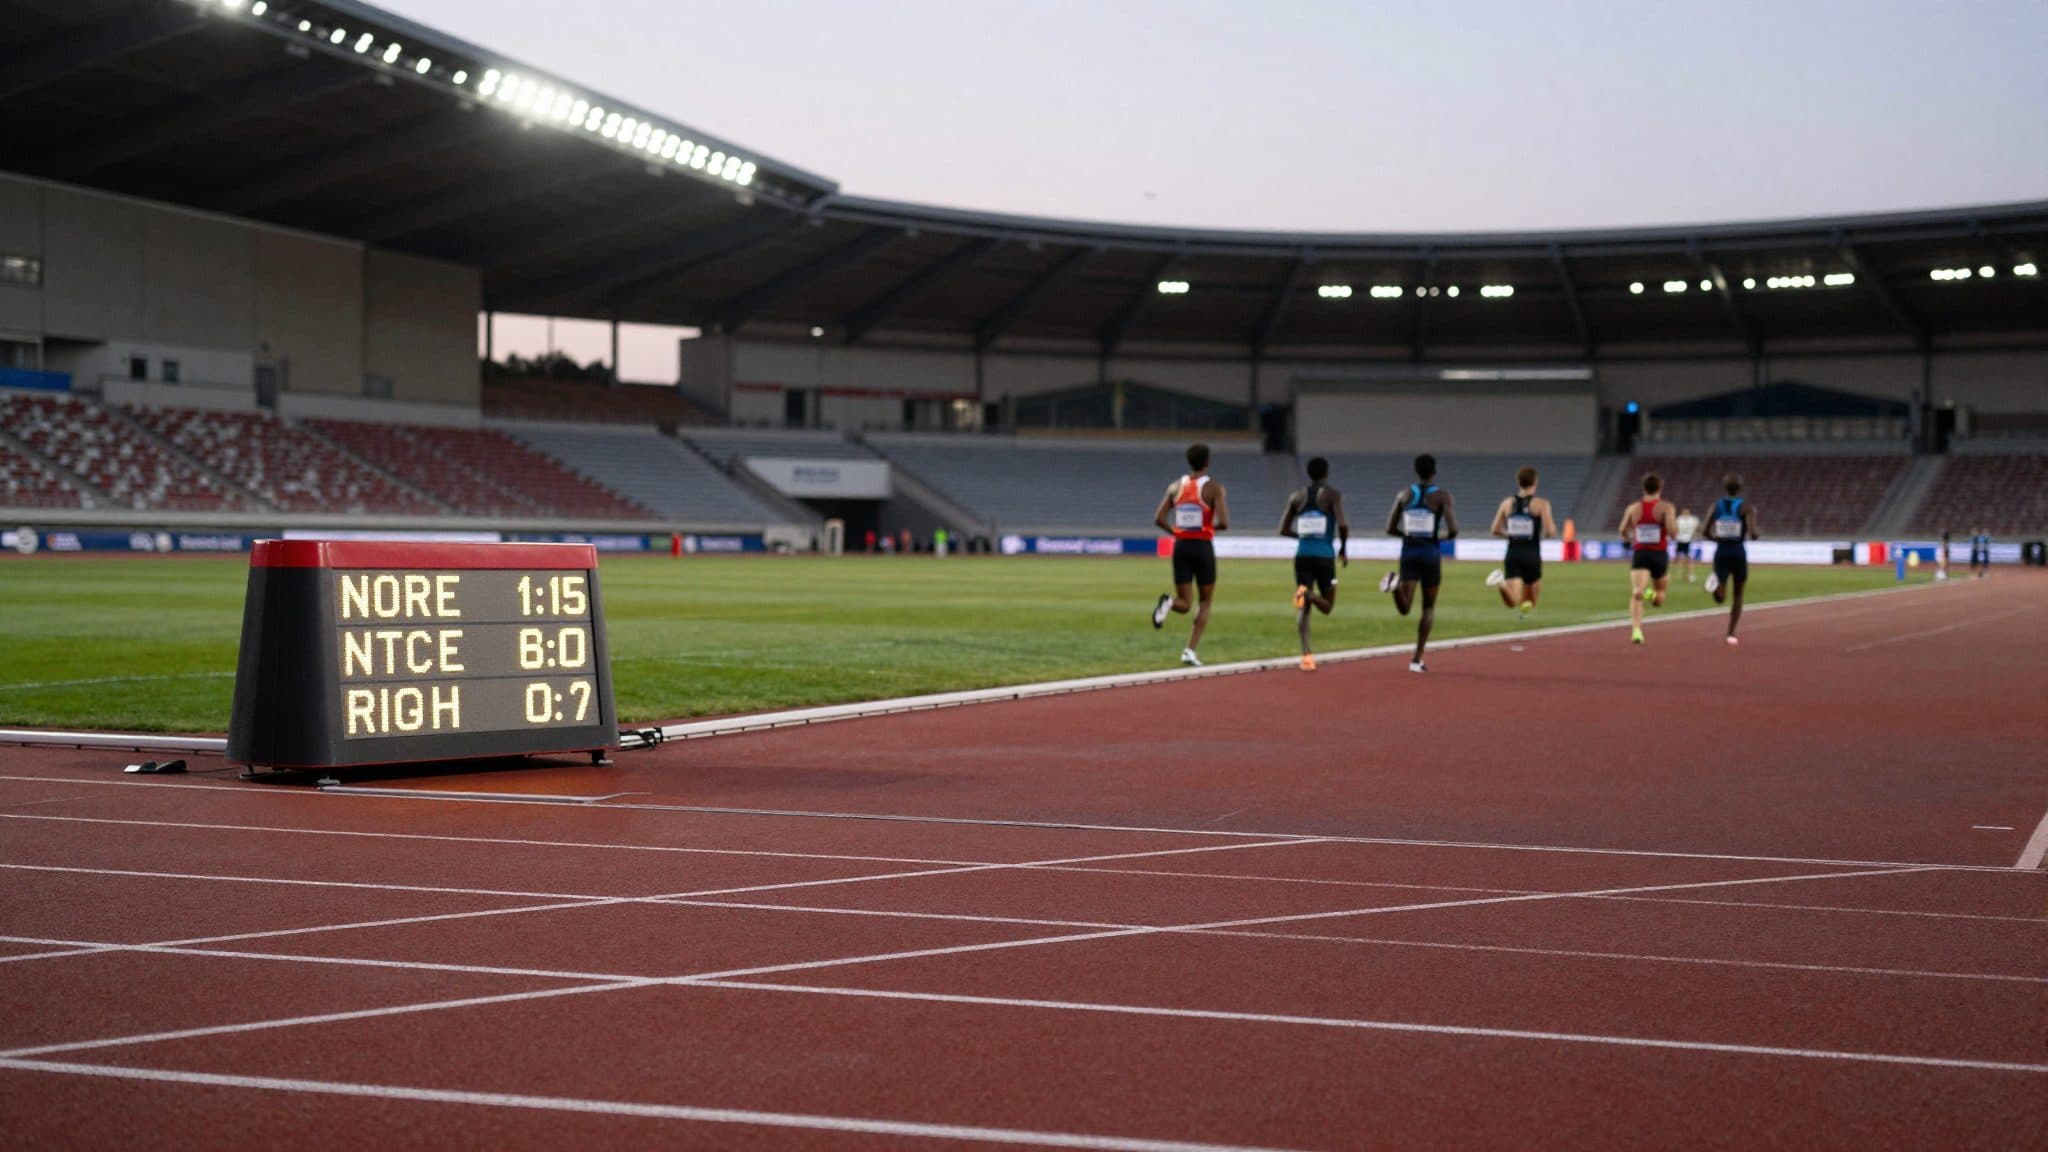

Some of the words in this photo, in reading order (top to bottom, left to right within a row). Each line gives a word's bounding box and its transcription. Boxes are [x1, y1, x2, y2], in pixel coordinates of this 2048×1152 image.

[341, 574, 461, 619] NORE
[517, 575, 587, 616] 1:15
[344, 629, 465, 676] NTCE
[347, 685, 460, 734] RIGH
